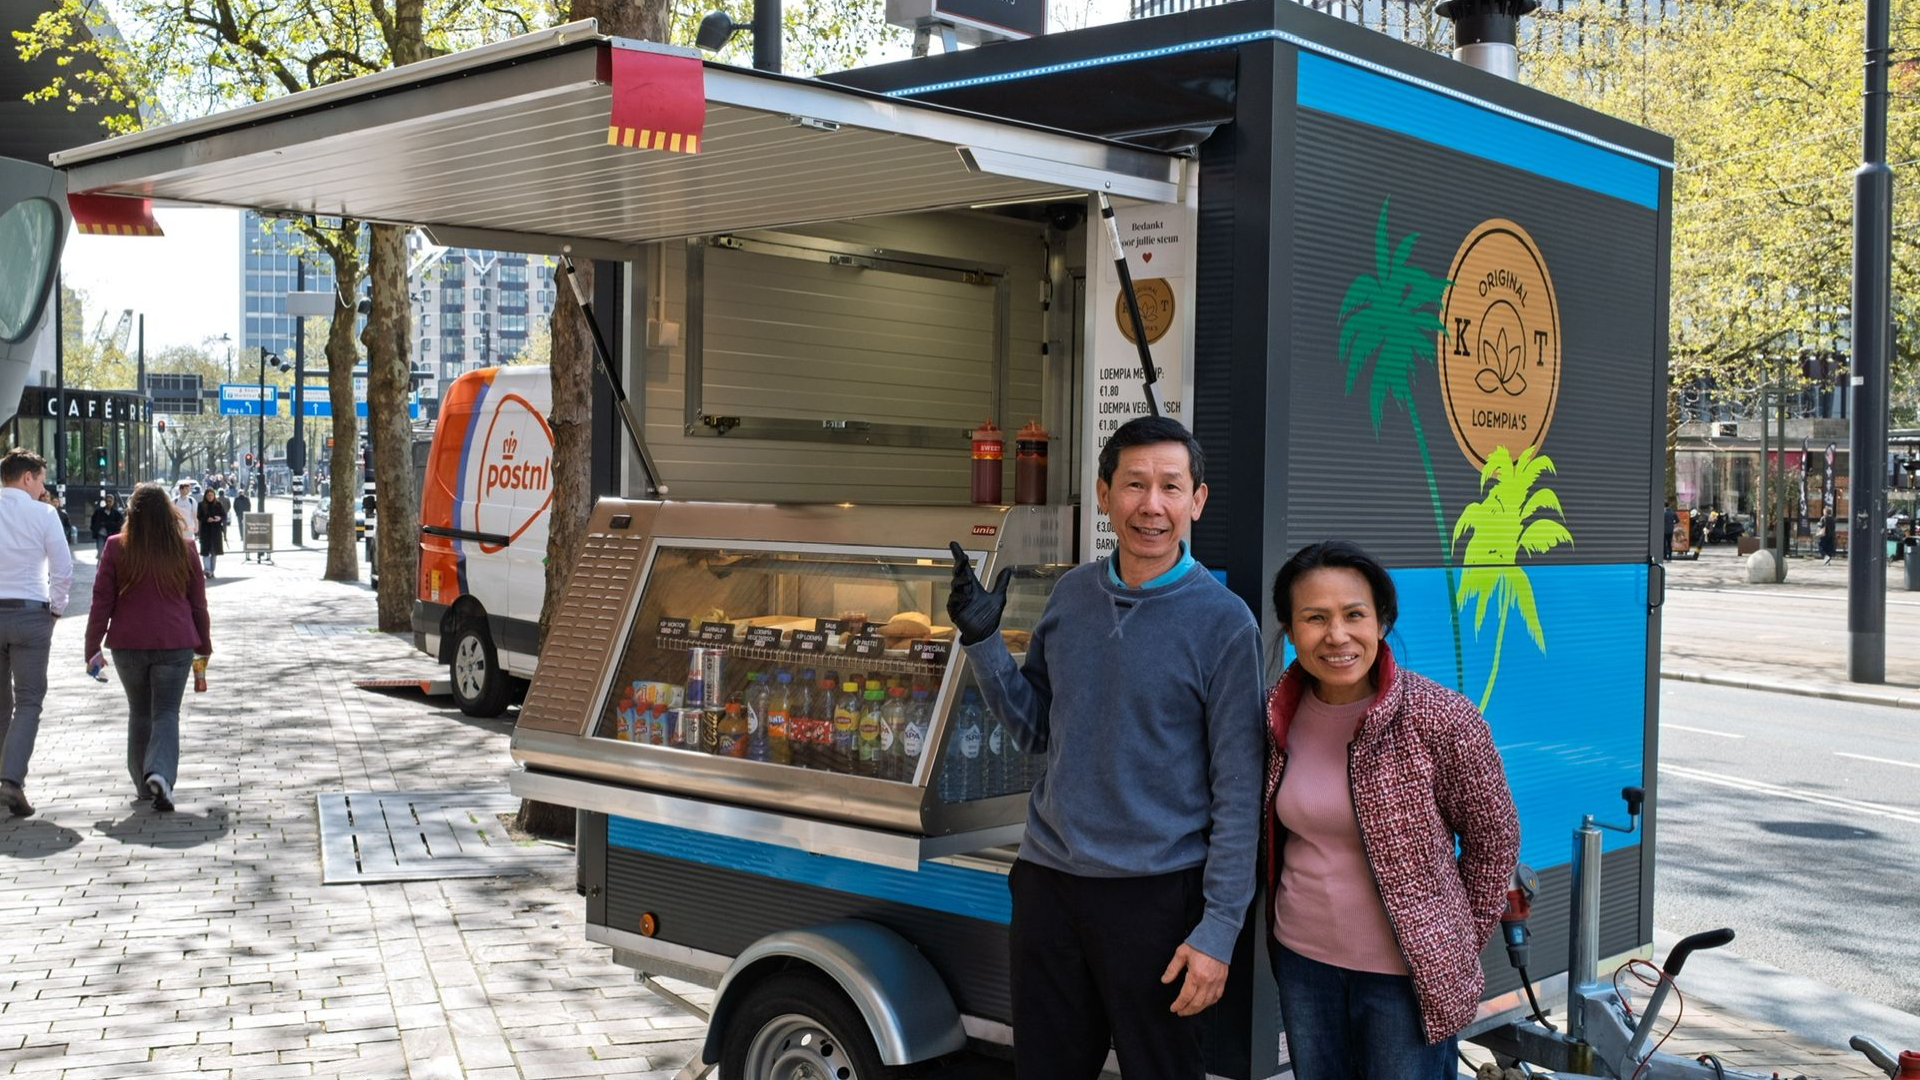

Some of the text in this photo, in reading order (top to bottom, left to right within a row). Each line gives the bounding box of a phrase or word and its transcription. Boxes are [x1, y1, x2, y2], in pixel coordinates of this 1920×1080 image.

[1131, 221, 1164, 231] Bedankt
[1121, 235, 1179, 249] oor jullie steun
[1478, 269, 1529, 309] ORIGINAL
[1160, 300, 1169, 312] T
[1453, 317, 1548, 367] K T
[1099, 367, 1165, 380] LOEMPIA ME IP:
[47, 398, 113, 419] CAFÉ
[1098, 401, 1181, 414] LOEMPIA VEGESCH
[1471, 408, 1527, 431] LOEMPIA'S
[486, 456, 550, 498] postnl
[972, 527, 996, 535] unis
[1095, 538, 1120, 550] GARN
[905, 731, 920, 740] SPA
